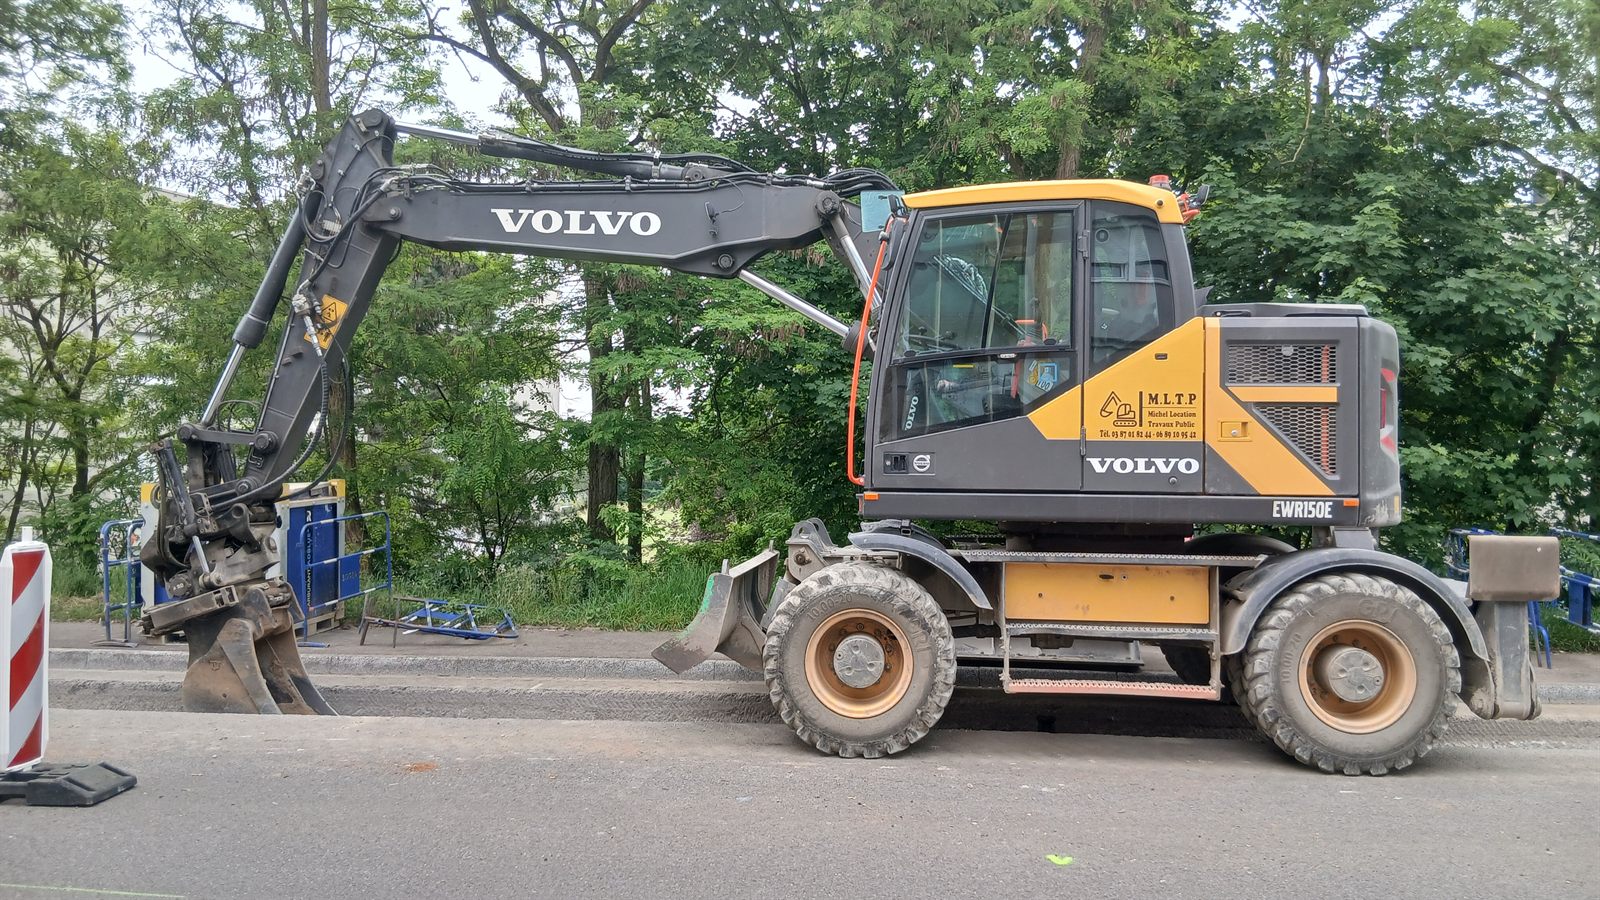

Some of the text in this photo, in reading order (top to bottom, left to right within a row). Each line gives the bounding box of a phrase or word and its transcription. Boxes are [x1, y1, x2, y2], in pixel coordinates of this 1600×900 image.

[490, 208, 662, 236] VOLVO
[1148, 393, 1197, 405] M.L.T.P
[904, 396, 919, 431] OLVO
[1148, 410, 1197, 418] Michel Location
[1148, 420, 1195, 428] Travaux Public
[1111, 431, 1119, 439] 03
[1120, 430, 1127, 439] 87
[1136, 430, 1143, 438] 82
[1144, 431, 1152, 439] 44
[1156, 430, 1163, 438] 06
[1164, 430, 1171, 439] 89
[1181, 431, 1188, 439] 95
[1086, 457, 1200, 474] VOLVO
[1272, 500, 1333, 519] EWR150E
